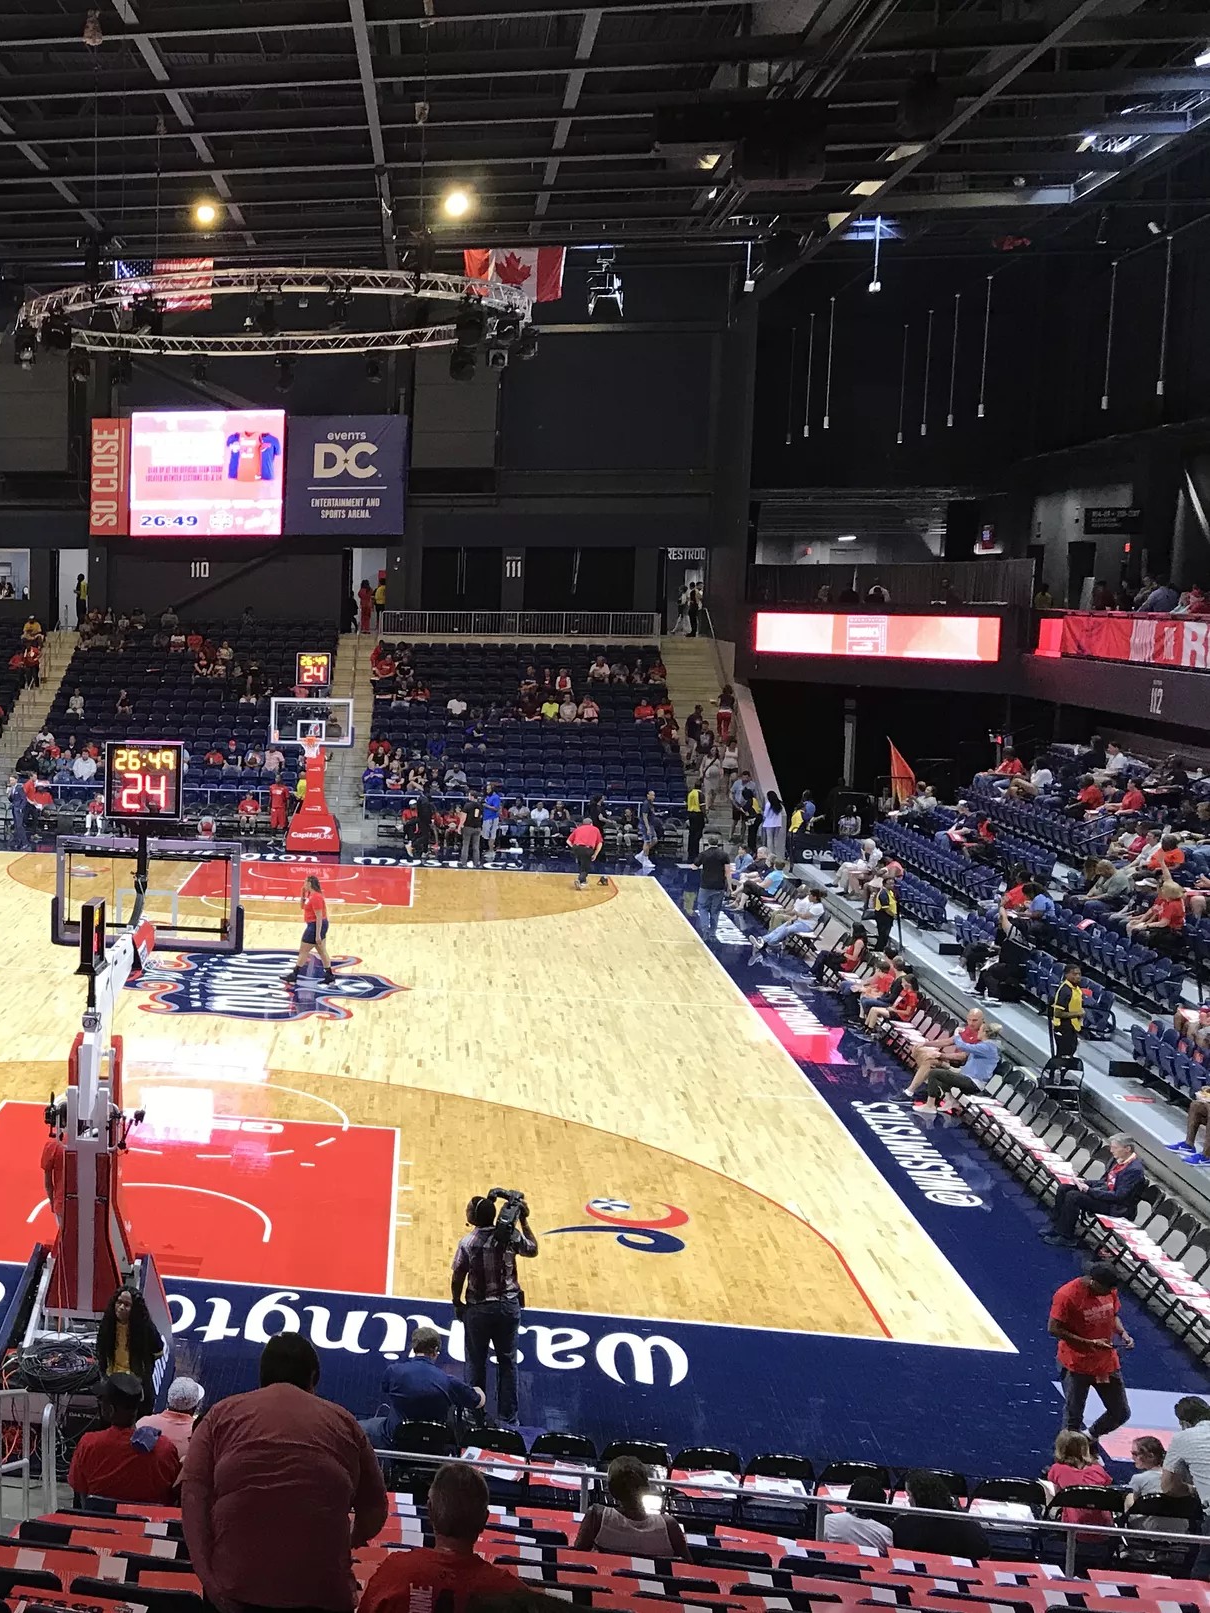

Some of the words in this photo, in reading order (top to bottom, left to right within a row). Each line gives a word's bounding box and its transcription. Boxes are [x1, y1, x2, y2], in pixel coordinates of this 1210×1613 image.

[327, 431, 367, 440] events
[92, 428, 119, 493] CLOSE
[314, 442, 379, 478] DC
[311, 498, 365, 507] ENTERTAINMENT
[366, 498, 380, 507] AND
[91, 500, 117, 527] SO
[141, 515, 198, 526] 26:49
[321, 509, 346, 519] SPORTS
[667, 548, 705, 560] RESTROO
[190, 561, 210, 578] 110
[506, 560, 521, 578] 111
[300, 655, 328, 666] 26:49
[303, 666, 324, 683] 24
[1150, 687, 1164, 714] 112
[115, 749, 175, 771] 26:49
[122, 773, 167, 809] 24
[756, 984, 831, 1036] WNBA.COM
[850, 1101, 984, 1208] @WASHMYSTICS
